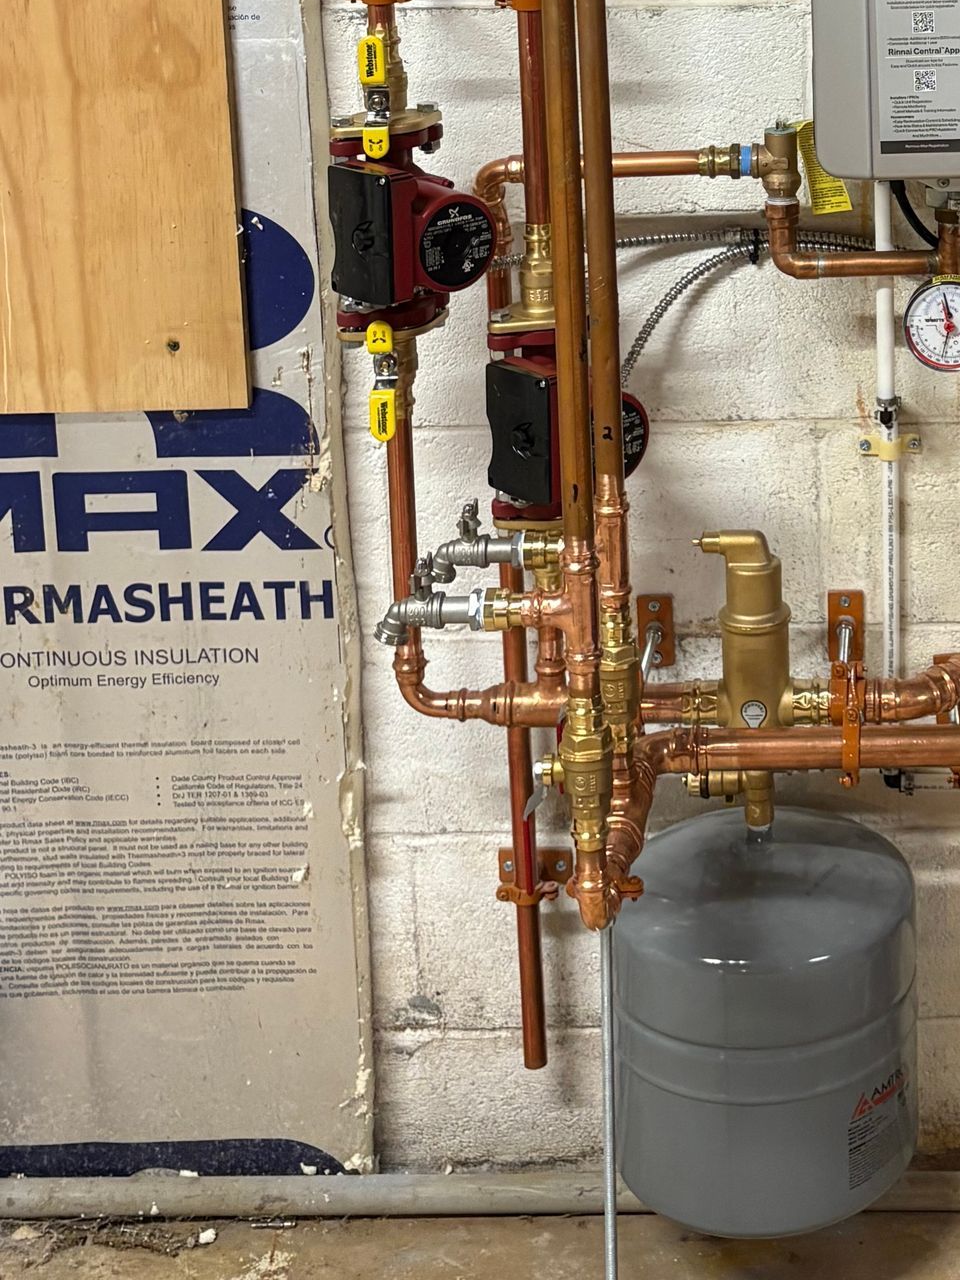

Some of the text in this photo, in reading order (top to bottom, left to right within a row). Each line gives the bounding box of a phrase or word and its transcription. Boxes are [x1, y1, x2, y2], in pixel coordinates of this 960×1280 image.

[888, 48, 914, 56] Rinnai
[944, 47, 960, 56] App
[602, 426, 613, 441] 2
[134, 647, 260, 665] INSULATION
[28, 673, 219, 688] Optimum Energy Efficiency
